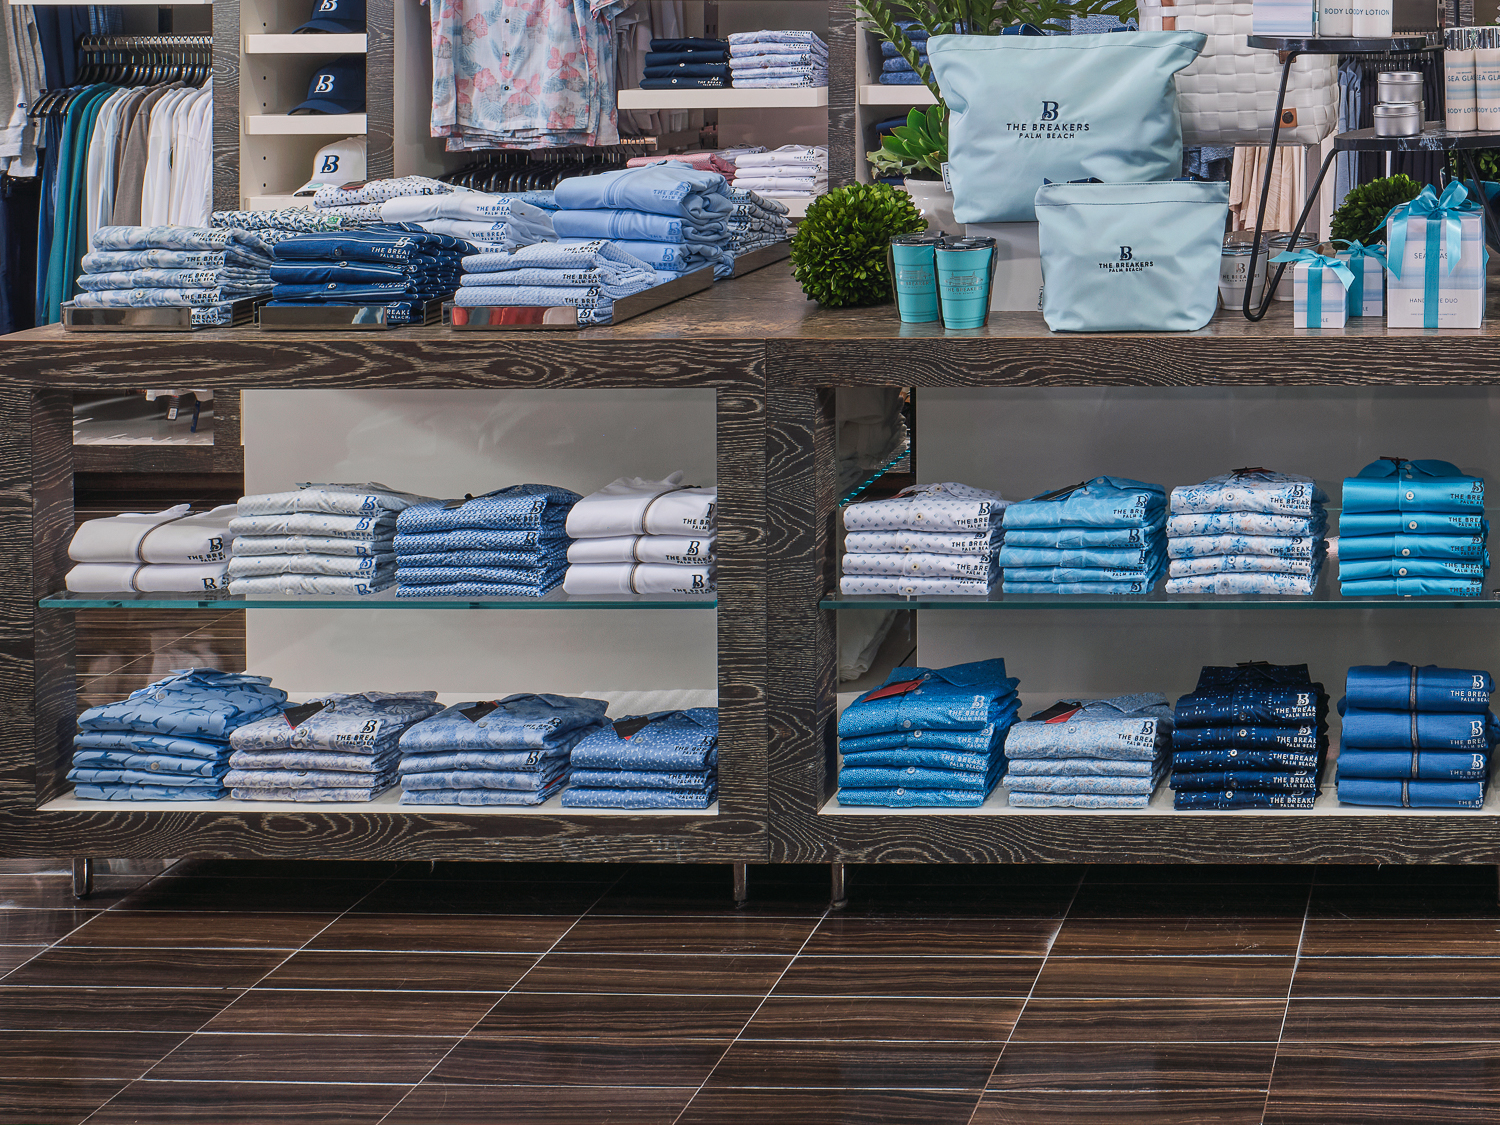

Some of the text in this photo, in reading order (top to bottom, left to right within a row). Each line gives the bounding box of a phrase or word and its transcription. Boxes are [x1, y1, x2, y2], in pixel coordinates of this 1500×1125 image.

[314, 74, 334, 93] B
[1040, 100, 1059, 121] B
[1006, 123, 1090, 131] THE BREAKERS
[320, 154, 340, 173] B
[1120, 246, 1132, 260] B
[978, 502, 991, 516] B
[208, 537, 223, 552] B
[686, 541, 700, 556] B
[691, 574, 704, 589] B
[1472, 675, 1484, 689] B
[1296, 694, 1310, 706] B
[360, 720, 378, 733] B
[1140, 721, 1154, 735] B
[1469, 721, 1484, 737] B
[1471, 754, 1484, 769] B
